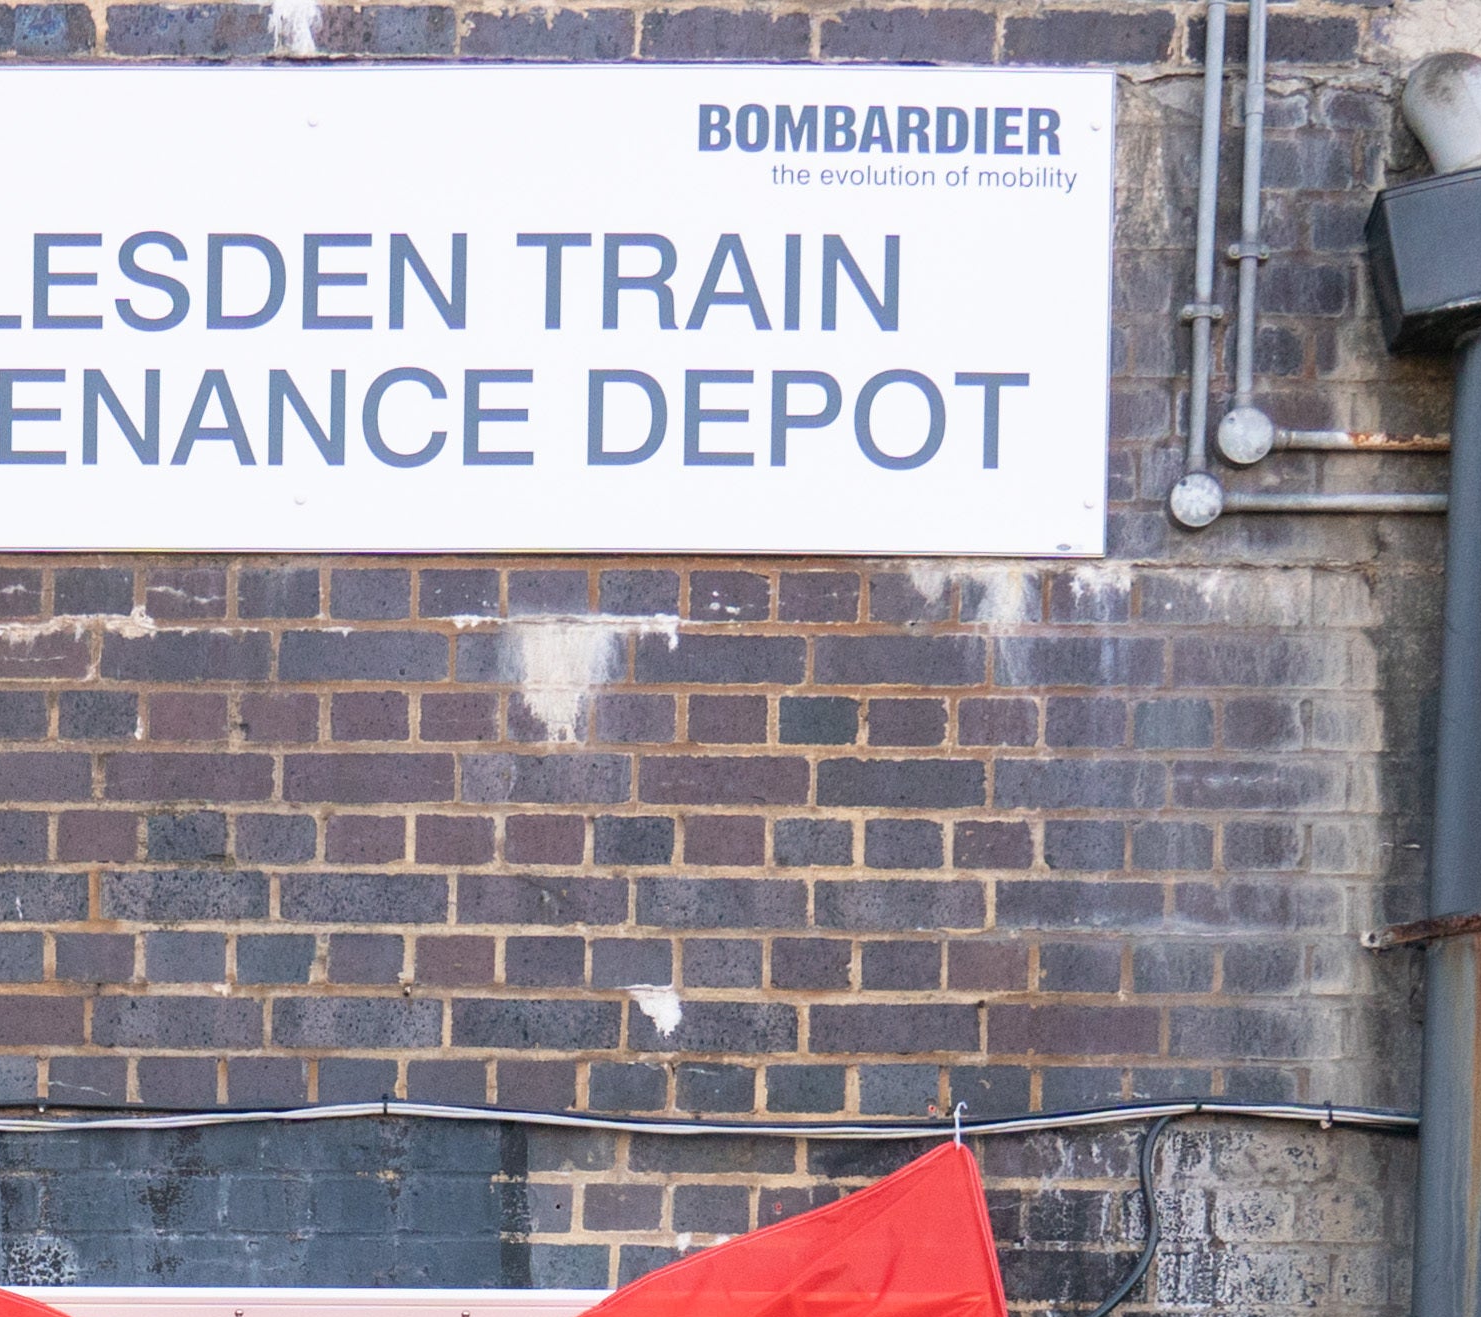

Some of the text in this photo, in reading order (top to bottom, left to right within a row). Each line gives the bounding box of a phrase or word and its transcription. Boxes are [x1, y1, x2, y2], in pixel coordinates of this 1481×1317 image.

[699, 103, 1060, 155] BOMBARDIER
[772, 165, 1077, 193] the evolution of mobility
[513, 232, 902, 335] TRAIN
[586, 371, 1030, 473] DEPOT
